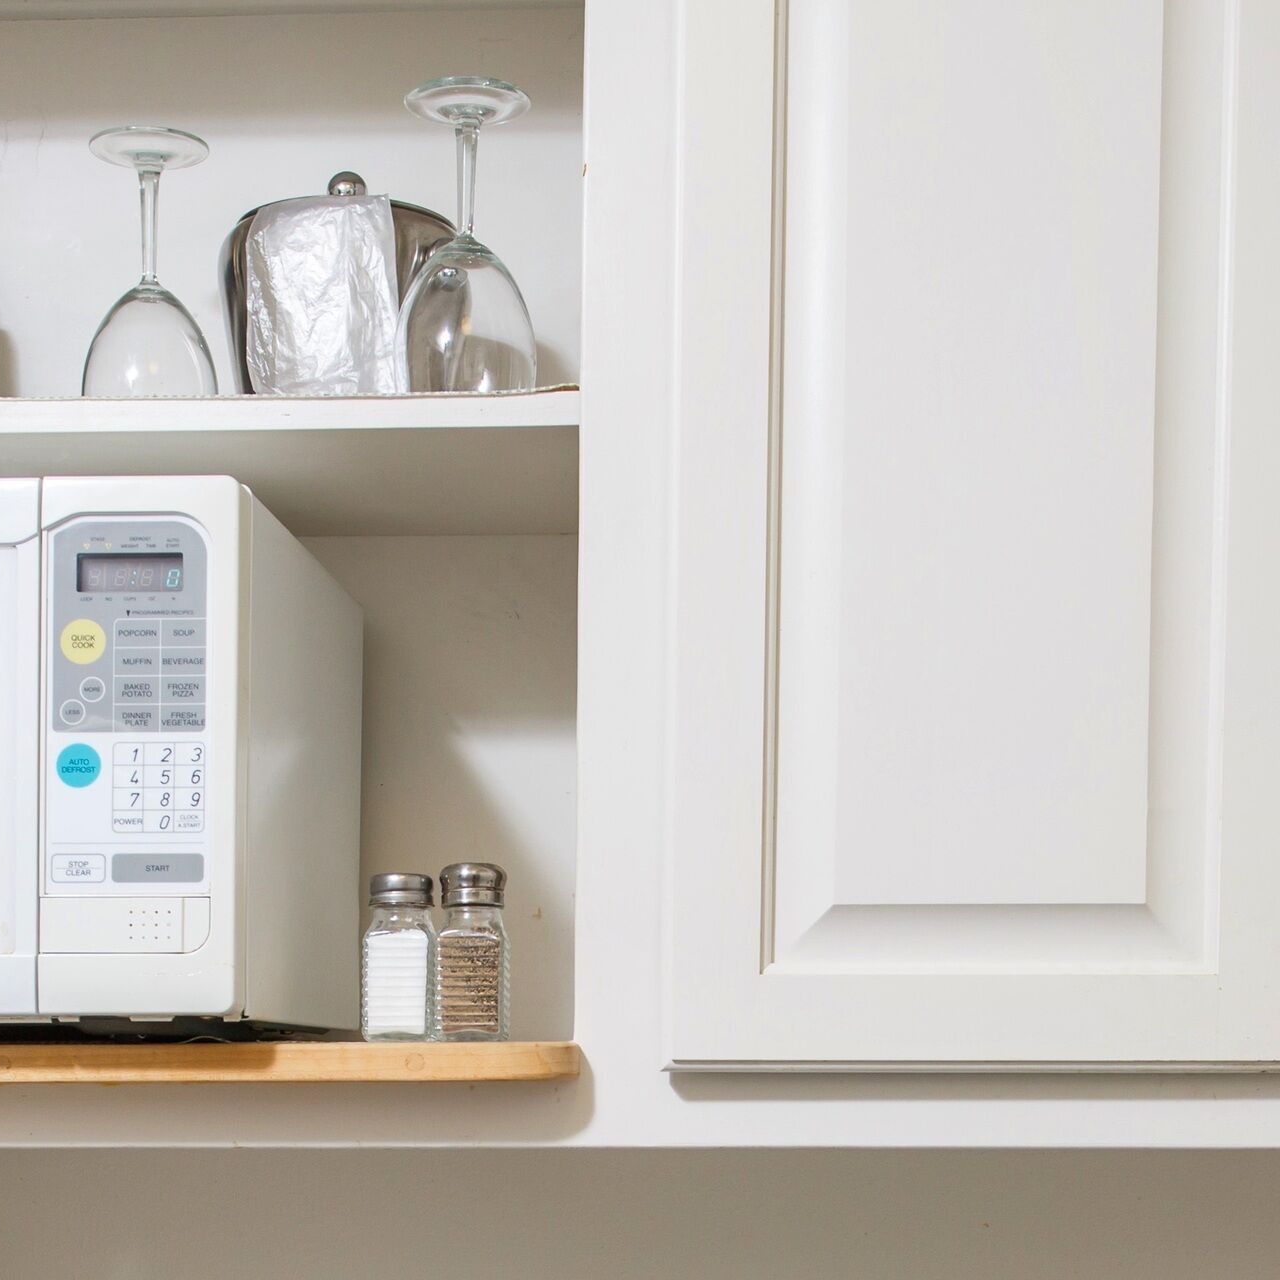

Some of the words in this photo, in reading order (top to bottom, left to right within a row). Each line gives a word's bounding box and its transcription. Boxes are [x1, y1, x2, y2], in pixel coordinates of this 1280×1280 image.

[71, 634, 96, 642] QUICK
[118, 629, 157, 637] POPCORN
[172, 629, 195, 637] SOUP
[72, 641, 95, 649] COOK
[68, 758, 90, 766] AUTO
[132, 748, 139, 763] 1
[160, 747, 173, 763] 2
[190, 747, 203, 763] 3
[61, 766, 96, 774] DEFROST
[130, 770, 140, 785] 4
[160, 769, 171, 785] 5
[190, 769, 202, 785] 6
[130, 792, 140, 808] 7
[160, 792, 171, 808] 8
[190, 792, 201, 807] 9
[114, 817, 143, 826] POWER
[159, 815, 171, 830] 0
[68, 861, 89, 869] STOP
[65, 869, 91, 877] CLEAR
